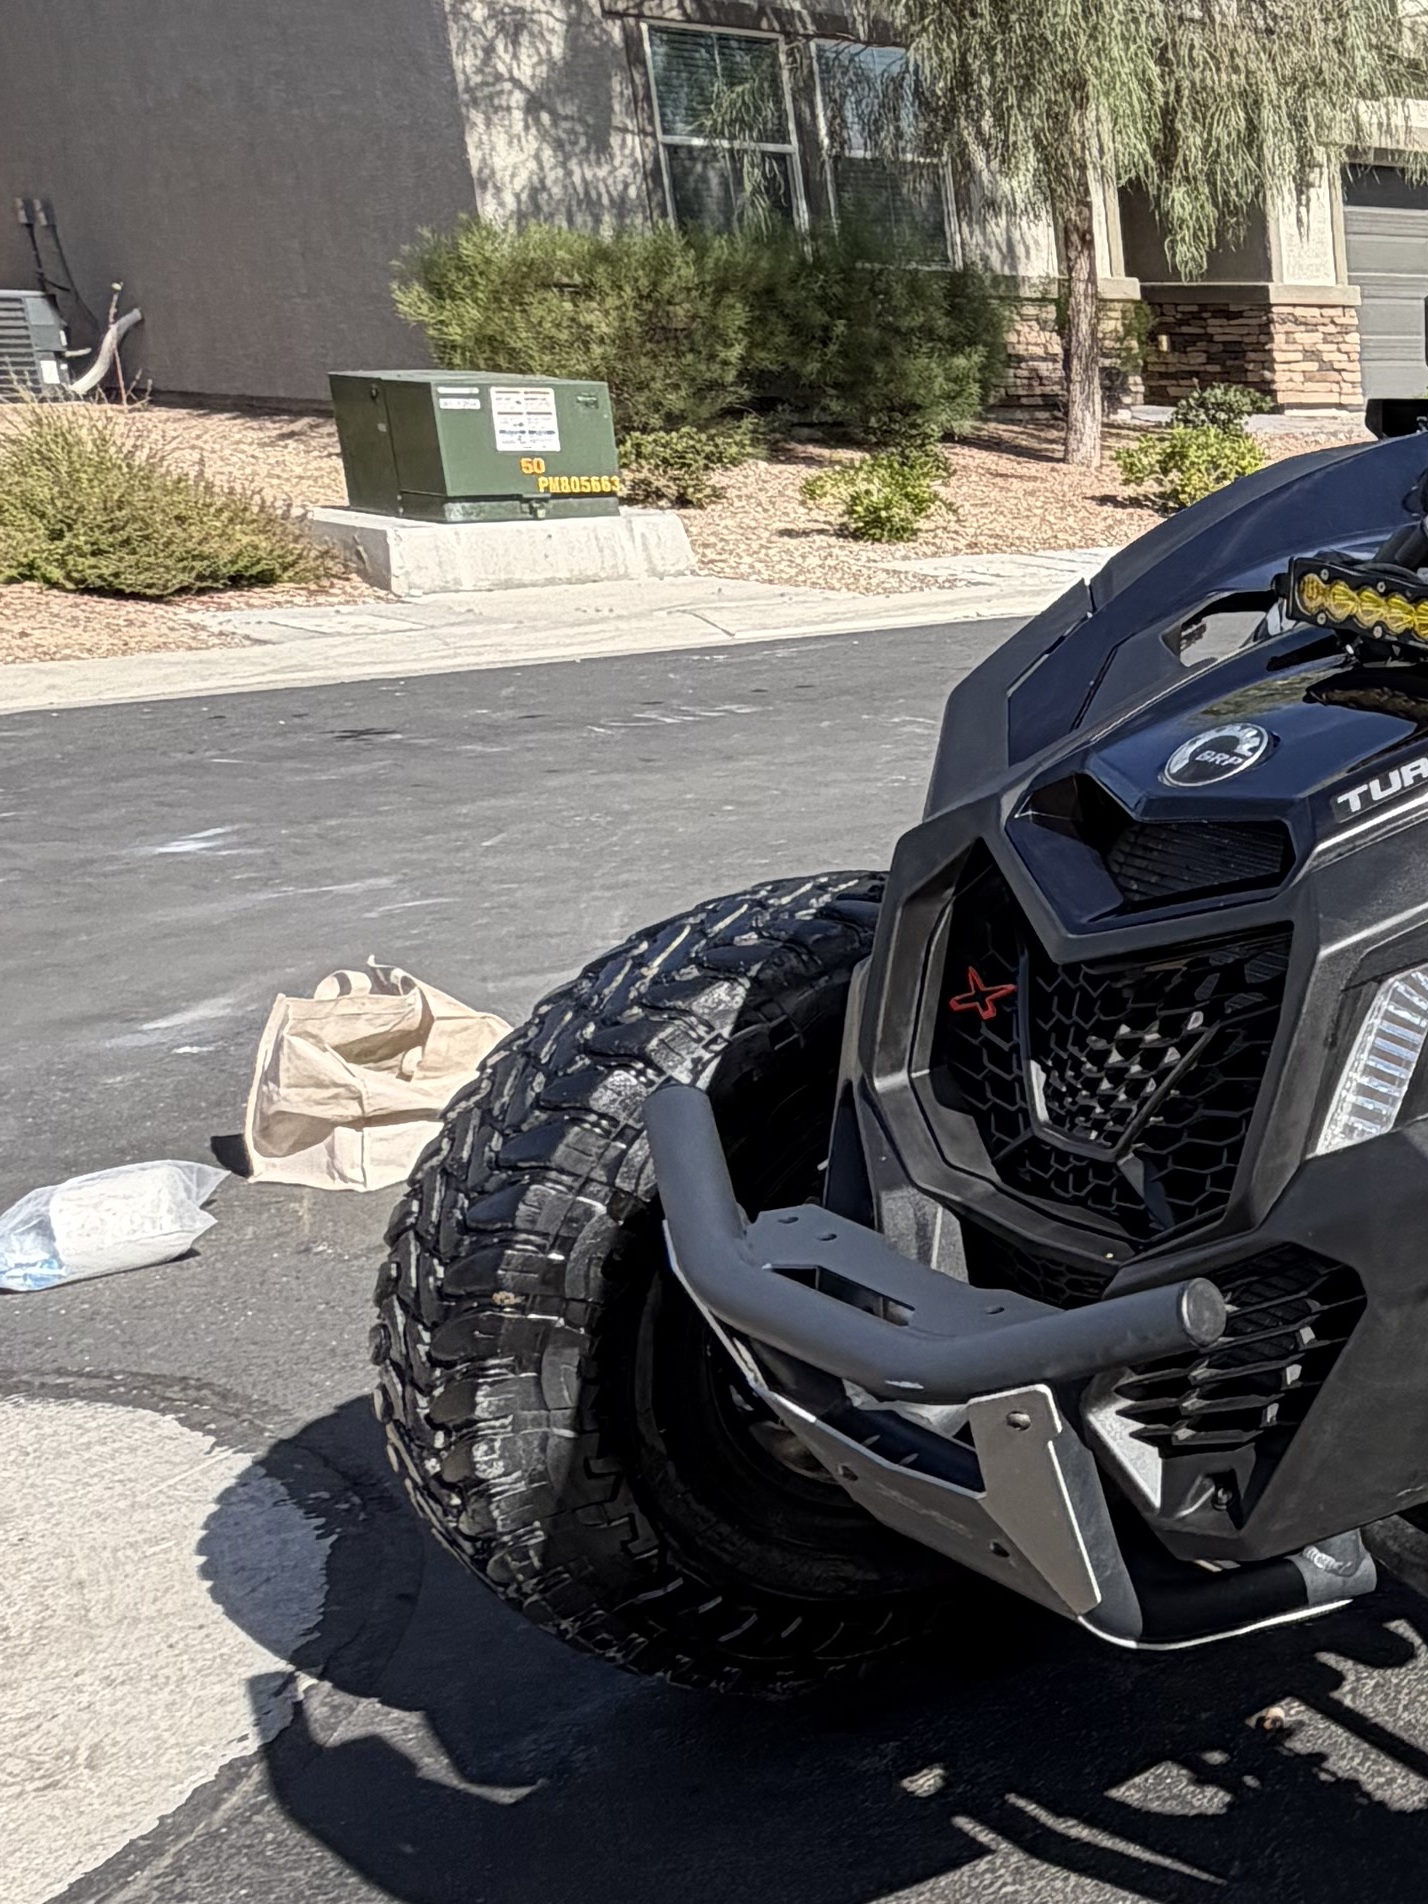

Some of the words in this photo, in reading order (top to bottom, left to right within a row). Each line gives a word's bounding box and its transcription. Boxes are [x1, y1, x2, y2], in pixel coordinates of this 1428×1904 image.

[520, 457, 546, 474] 50
[538, 475, 620, 493] PM805663
[1195, 750, 1244, 766] BRP
